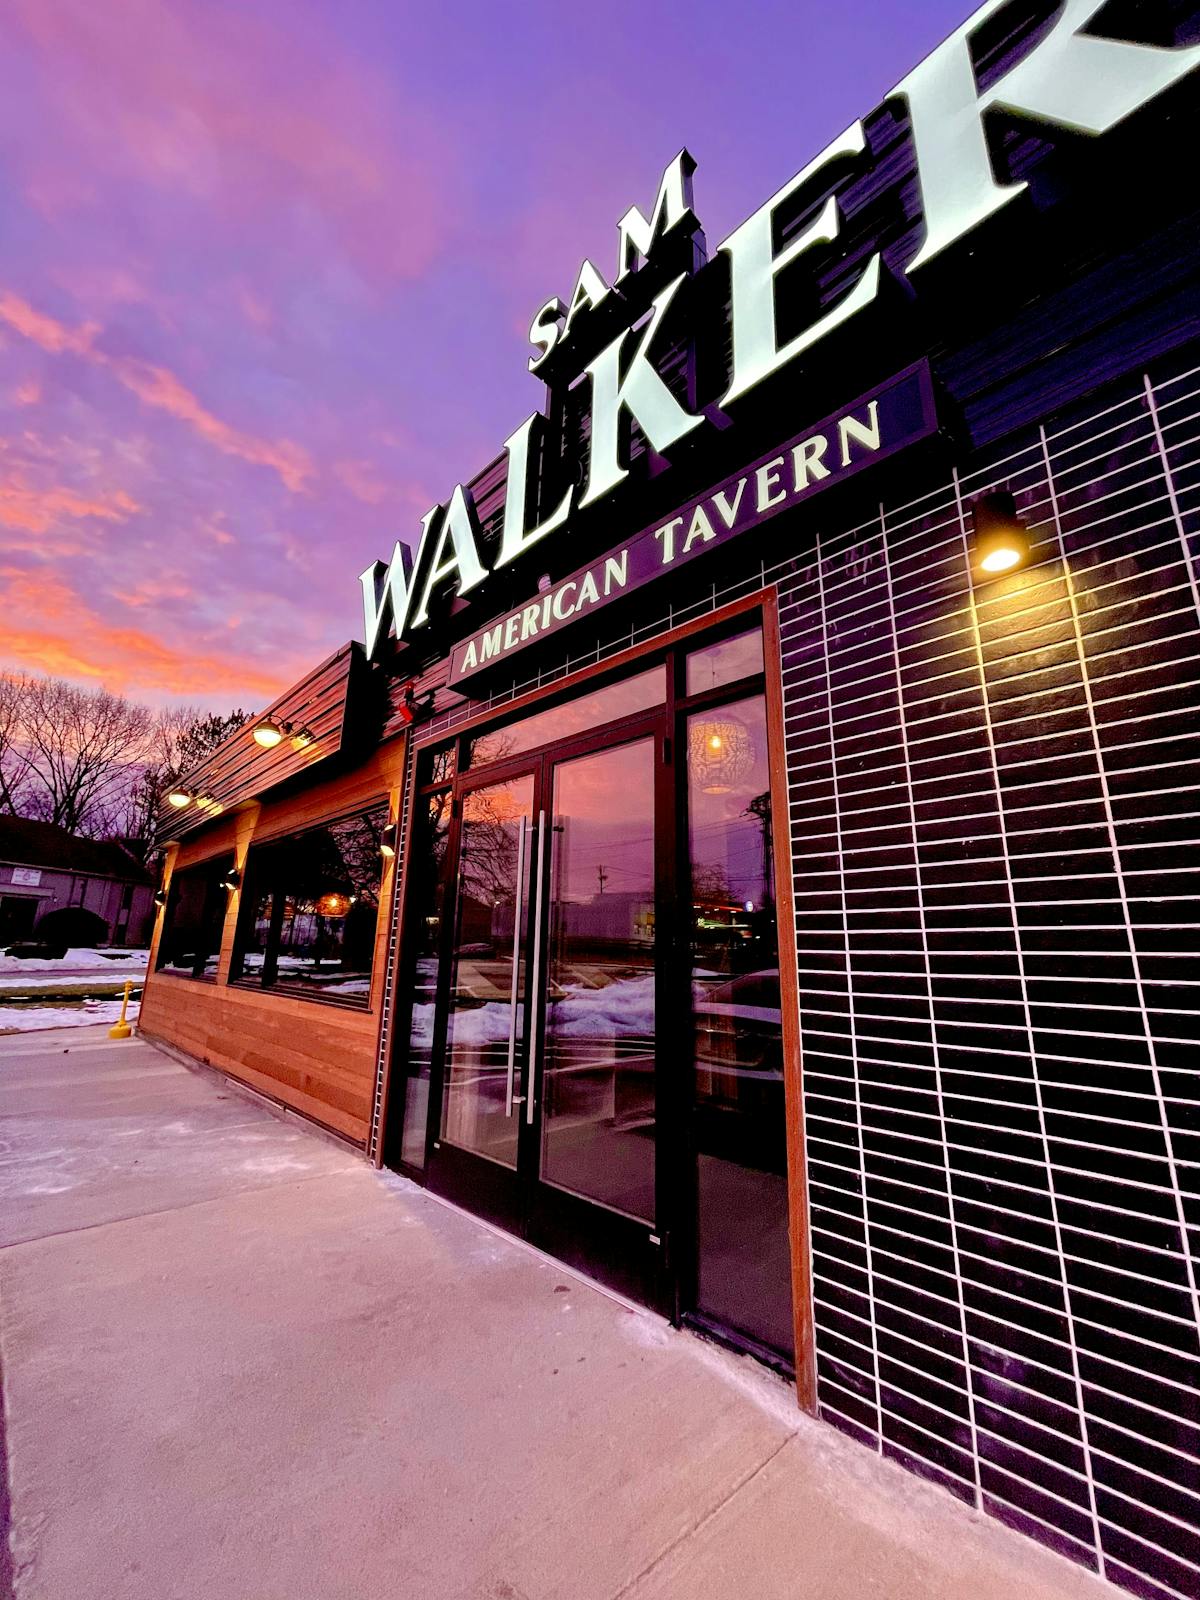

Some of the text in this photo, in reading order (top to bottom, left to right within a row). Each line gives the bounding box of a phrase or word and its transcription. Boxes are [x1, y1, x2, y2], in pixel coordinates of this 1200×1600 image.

[358, 0, 1200, 661] WALKER
[528, 148, 690, 371] SAM
[460, 400, 880, 673] AMERICAN TAVERN
